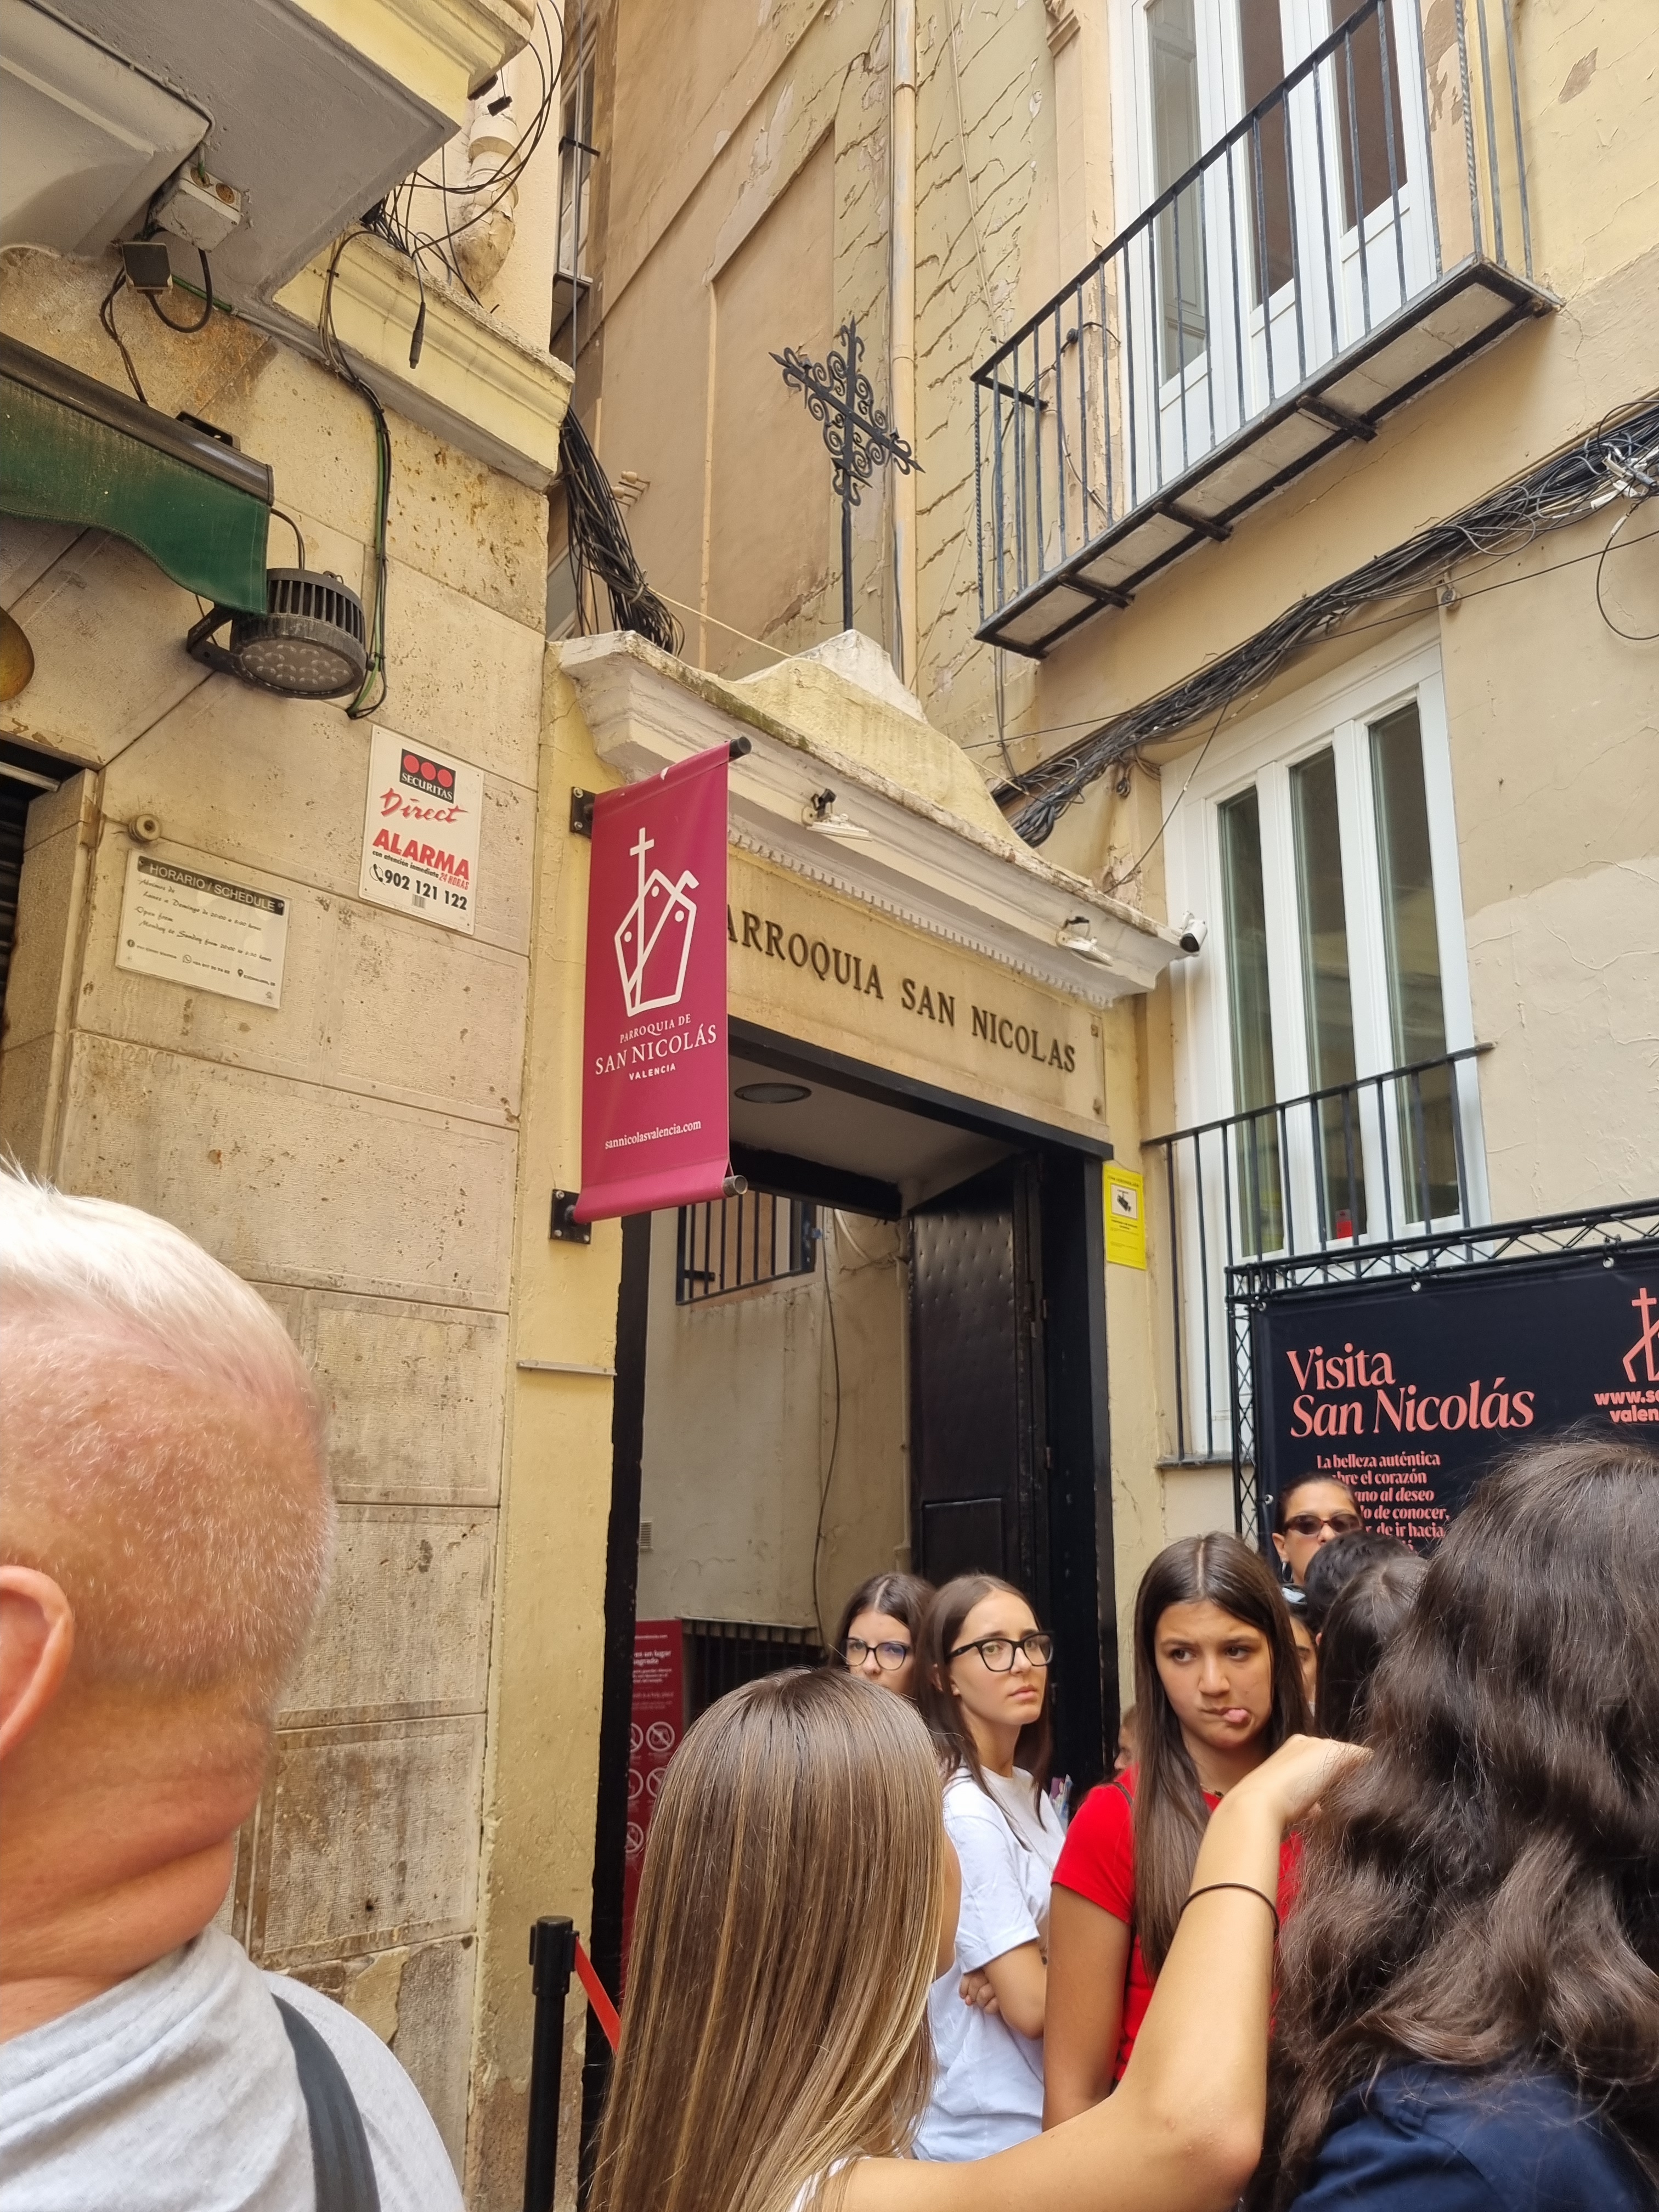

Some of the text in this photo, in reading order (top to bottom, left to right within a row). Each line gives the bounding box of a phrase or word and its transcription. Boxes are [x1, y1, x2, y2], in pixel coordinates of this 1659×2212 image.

[402, 772, 453, 800] SECURITAS
[380, 788, 470, 823] Direct
[373, 828, 470, 881] ALARMA
[410, 862, 439, 878] inmediata
[150, 863, 206, 889] HORARIO
[214, 884, 275, 911] SCHEDULE
[385, 869, 467, 911] 902 121 122
[172, 899, 201, 914] Domingo
[138, 920, 166, 934] Monday
[176, 930, 203, 944] Sunday
[728, 904, 1076, 1073] ARROQUIA SAN NICOLAS
[620, 1014, 691, 1043] PARROQUIA DE
[595, 1023, 717, 1075] SAN NICOLÁS
[629, 1063, 676, 1081] VALENCIA
[605, 1120, 701, 1150] sannicolasvalencia.com
[1286, 1342, 1396, 1391] Visita
[1290, 1376, 1535, 1437] San Nicolás
[1317, 1450, 1441, 1469] La belleza auténtica
[1332, 1468, 1427, 1485] bre el corazón
[1380, 1487, 1393, 1502] al
[1395, 1487, 1435, 1502] deseo
[1374, 1505, 1391, 1520] de
[1392, 1508, 1451, 1521] conocer,
[1376, 1522, 1394, 1536] de
[1395, 1522, 1407, 1537] ir
[1408, 1522, 1446, 1538] hacia
